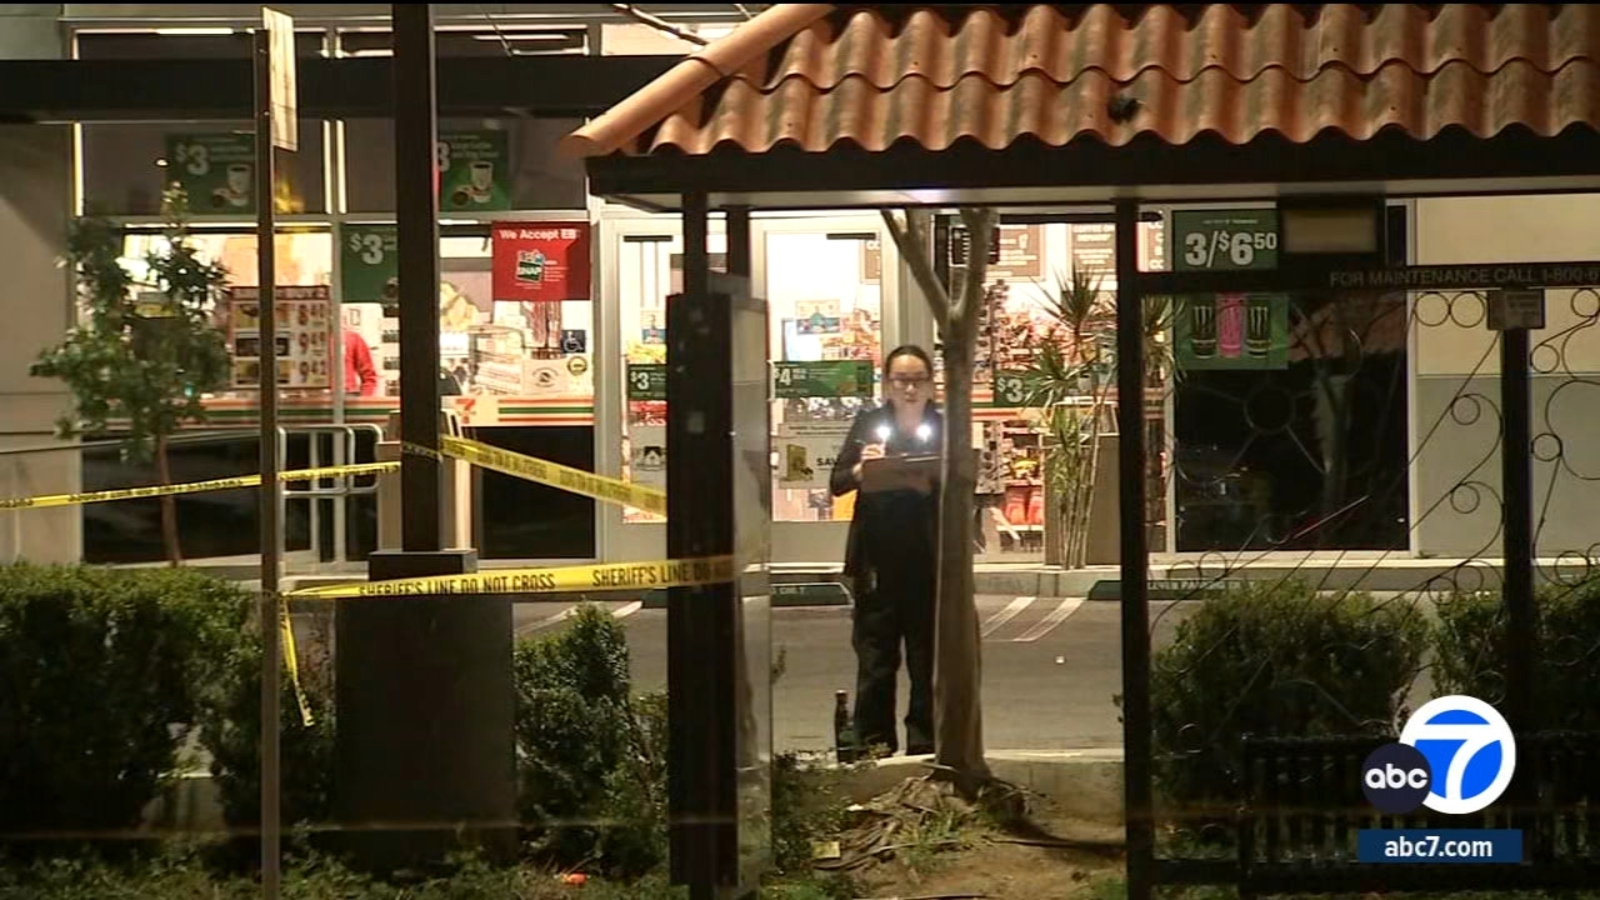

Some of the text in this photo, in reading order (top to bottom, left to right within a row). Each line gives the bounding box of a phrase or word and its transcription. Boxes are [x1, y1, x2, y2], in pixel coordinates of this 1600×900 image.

[175, 142, 209, 175] $3
[499, 229, 517, 239] We
[520, 229, 559, 241] Accept
[350, 233, 383, 265] $3
[1330, 271, 1364, 287] FOR
[1370, 268, 1489, 286] MAINTENANCE
[1494, 268, 1536, 283] CALL
[629, 371, 650, 390] $3
[997, 376, 1023, 404] $3
[428, 579, 455, 594] LINE
[460, 578, 478, 592] DO
[483, 576, 508, 591] NOT
[513, 573, 556, 590] CROSS
[592, 565, 657, 587] SHERIFF'S
[660, 561, 689, 583] LINE
